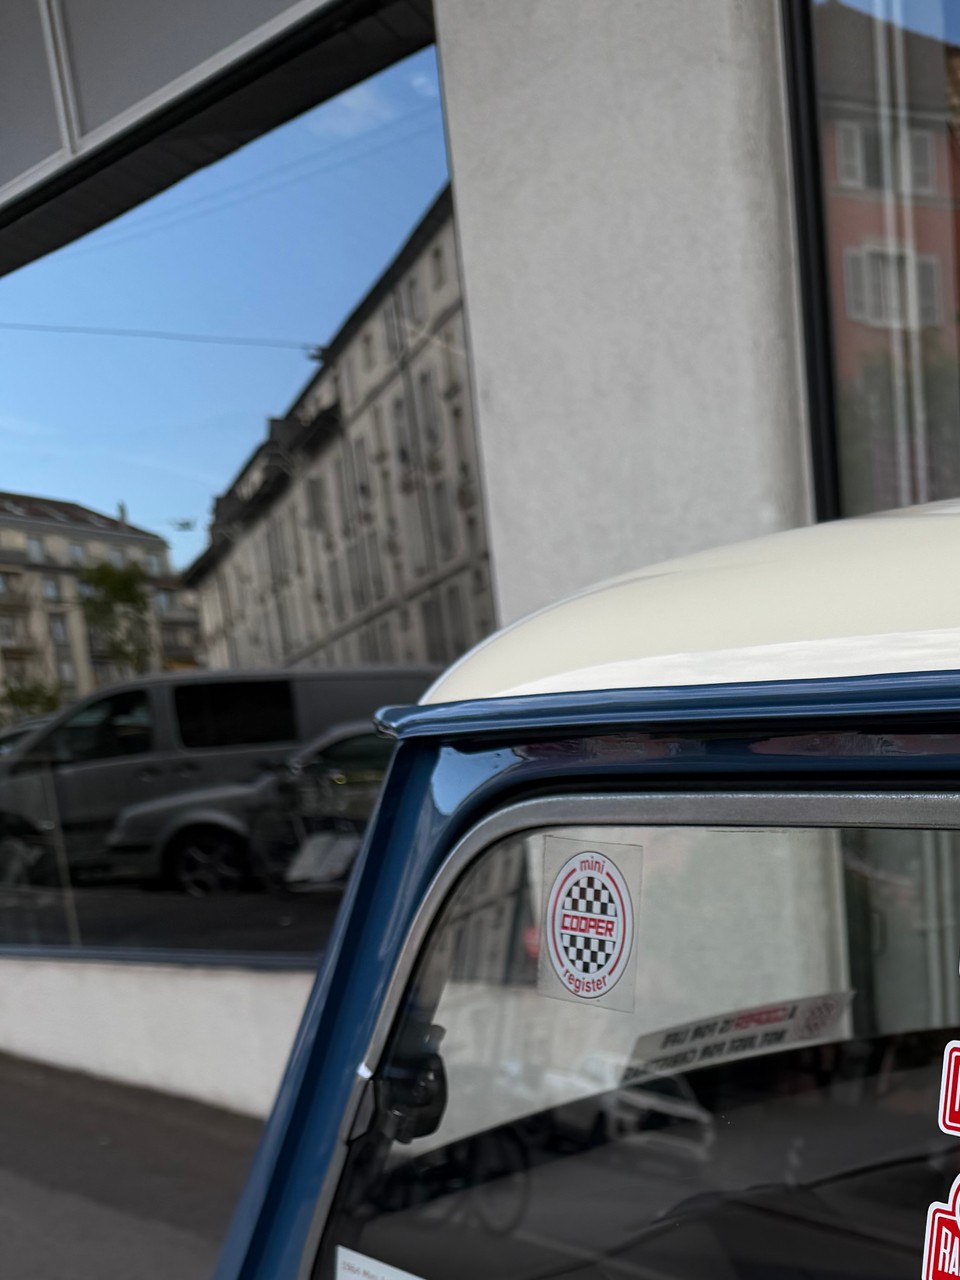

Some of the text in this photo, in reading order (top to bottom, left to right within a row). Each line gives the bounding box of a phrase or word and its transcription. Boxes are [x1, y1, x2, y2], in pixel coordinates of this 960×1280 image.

[579, 856, 606, 875] mini
[561, 913, 616, 938] COOPER
[562, 967, 607, 993] register
